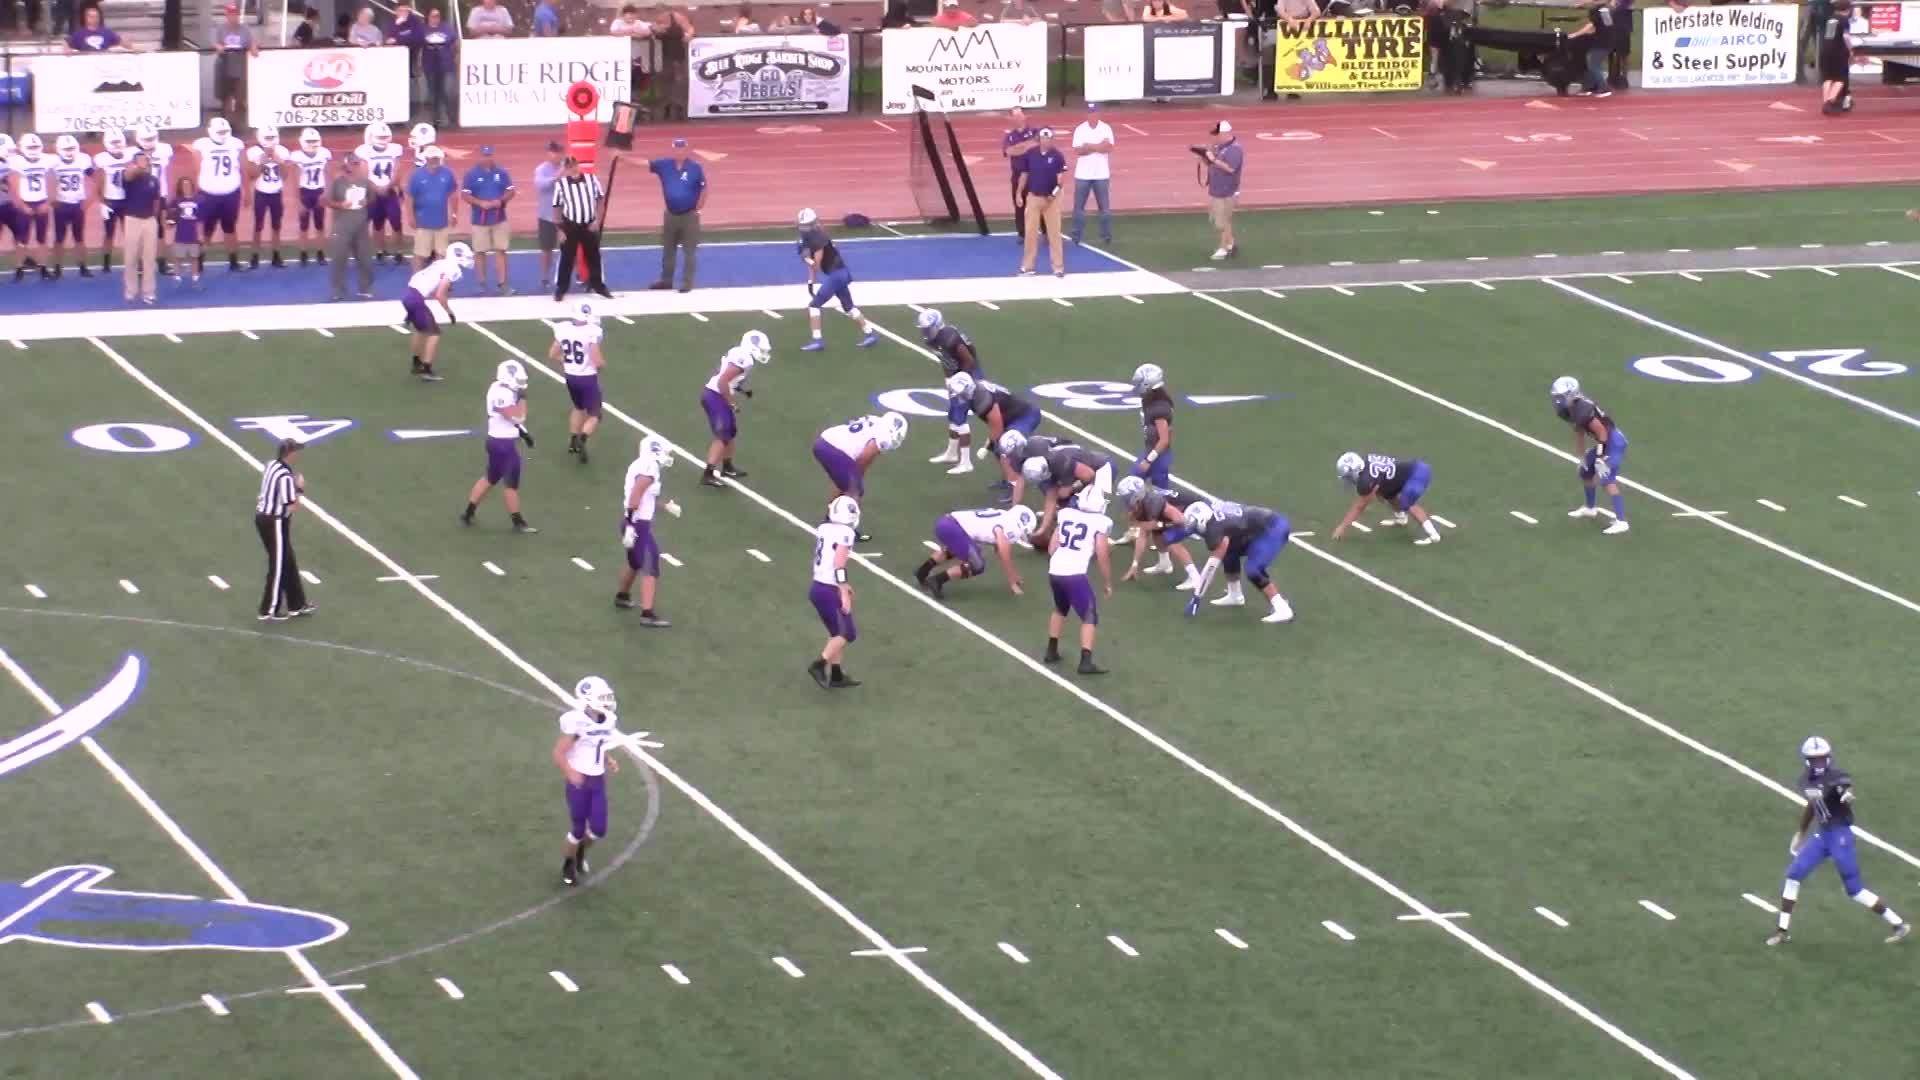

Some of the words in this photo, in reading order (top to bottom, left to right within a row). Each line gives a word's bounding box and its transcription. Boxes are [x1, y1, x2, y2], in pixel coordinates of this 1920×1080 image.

[1279, 19, 1421, 39] WILLIAMS
[1655, 10, 1724, 35] Interstate
[1729, 9, 1784, 39] Welding
[1341, 37, 1421, 59] TIRE
[1720, 34, 1768, 46] AIRCO
[905, 63, 972, 74] MOUNTAIN
[976, 60, 1022, 70] VALLEY
[1341, 61, 1374, 70] BLUE
[1377, 60, 1419, 69] RIDGE
[1652, 50, 1664, 69] &
[1672, 53, 1719, 70] Steel
[1726, 48, 1787, 71] Supply
[466, 63, 529, 86] BLUE
[540, 60, 626, 84] RIDGE
[939, 75, 991, 85] MOTORS
[1361, 70, 1411, 81] ELLIJAY
[952, 98, 976, 107] RAM
[275, 107, 386, 124] 706-258-2883
[211, 155, 232, 176] 79
[373, 161, 393, 180] 44
[561, 338, 585, 365] 26
[1060, 520, 1088, 551] 52
